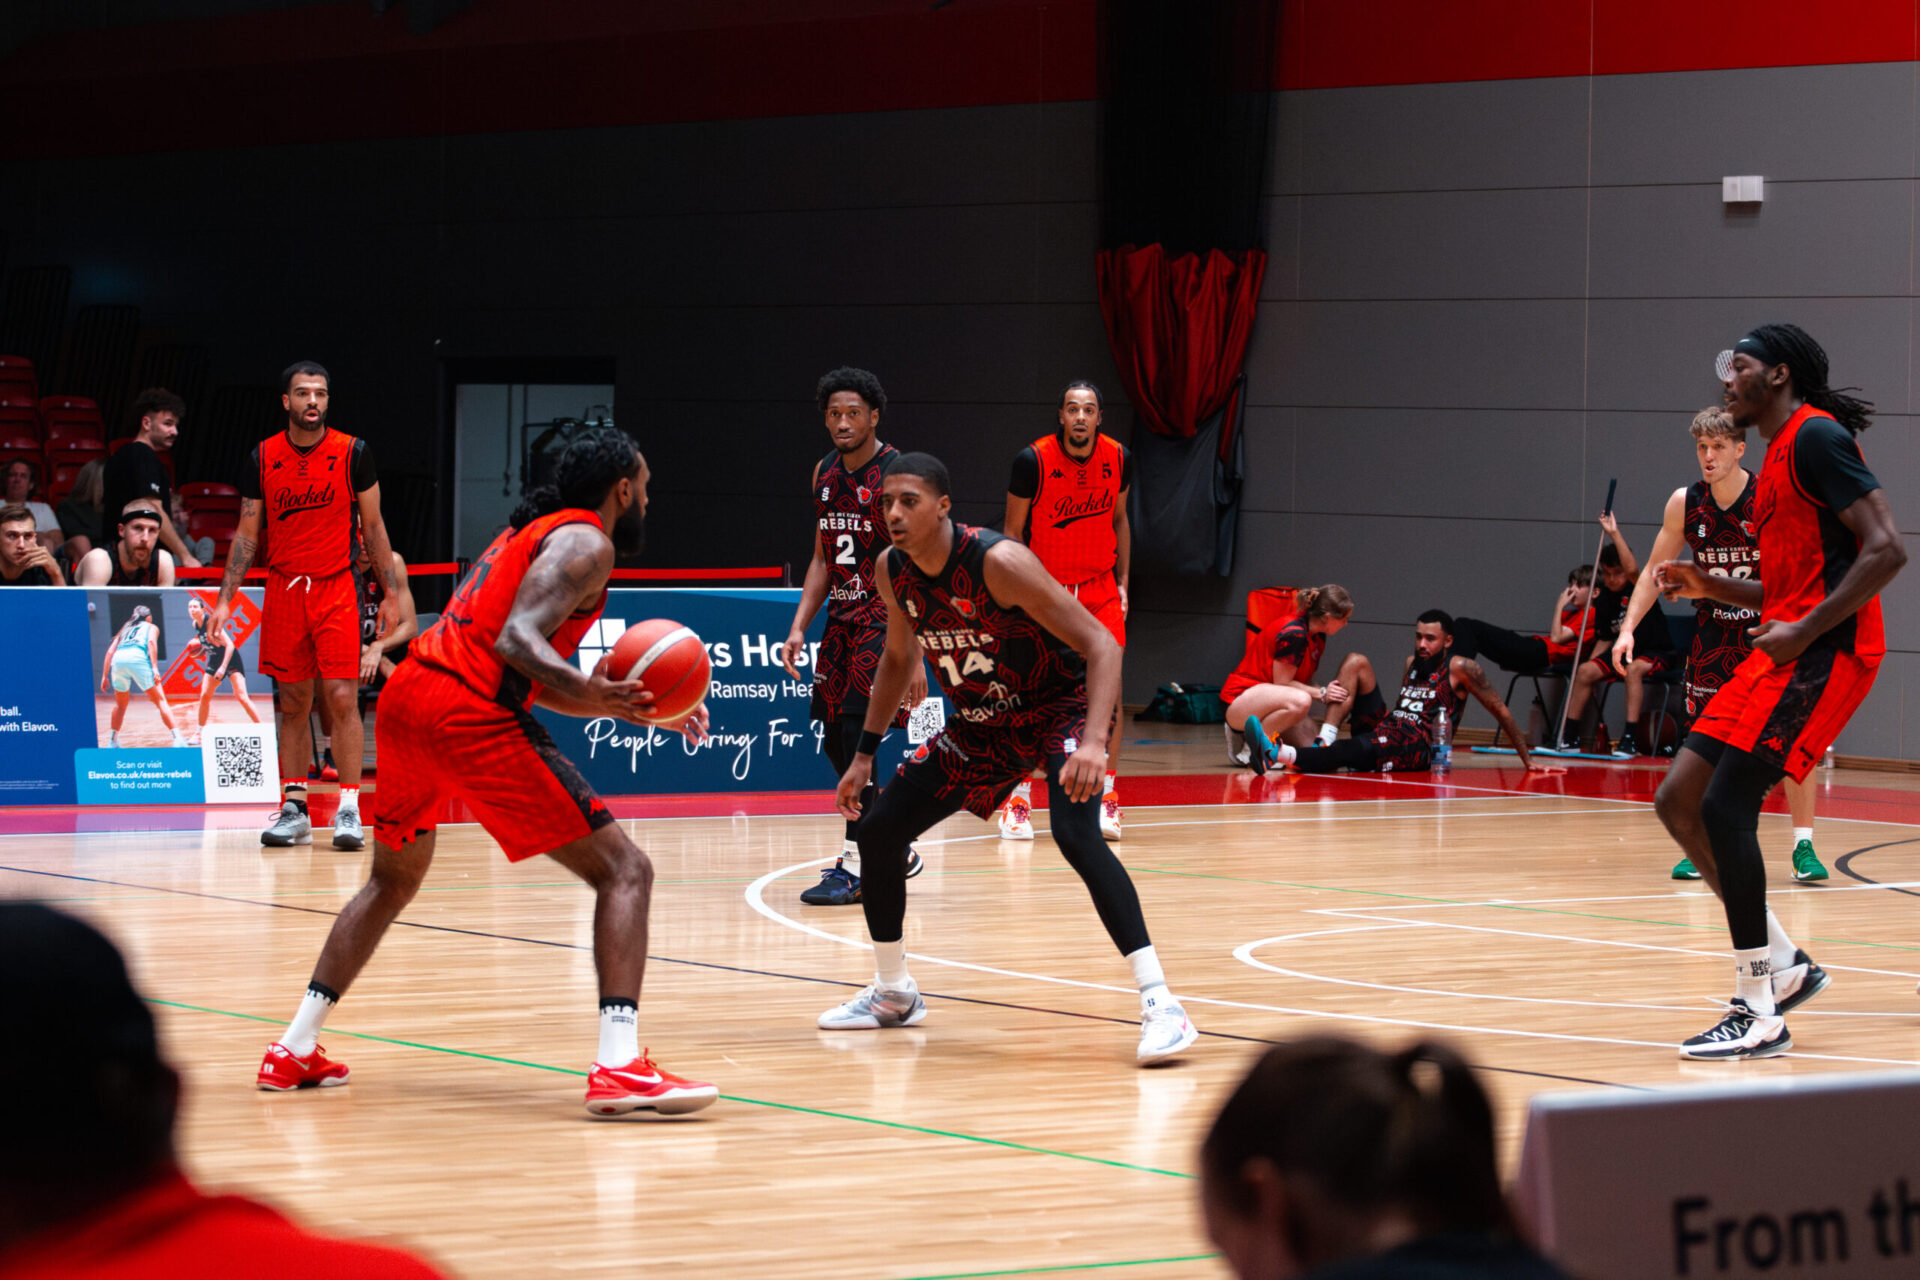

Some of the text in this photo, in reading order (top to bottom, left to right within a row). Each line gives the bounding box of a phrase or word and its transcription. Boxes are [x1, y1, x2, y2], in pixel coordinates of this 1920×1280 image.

[326, 456, 338, 471] 7
[1102, 462, 1112, 479] 5
[272, 481, 336, 512] Rockets
[1049, 488, 1113, 519] Rockets
[819, 518, 873, 532] REBELS
[835, 534, 857, 564] 2
[1697, 550, 1761, 563] REBELS
[916, 633, 994, 650] REBELS
[938, 651, 995, 687] 14
[710, 680, 778, 702] Ramsay
[0, 706, 22, 716] ball.
[0, 721, 59, 732] with Elavon.
[584, 716, 670, 774] People
[768, 718, 803, 757] For
[116, 760, 136, 769] Scan
[146, 760, 163, 769] visit
[88, 770, 192, 780] Elavon.co.uk/essex-rebels
[110, 781, 119, 790] to
[120, 781, 136, 789] find
[136, 781, 150, 789] out
[1672, 1195, 1851, 1277] From
